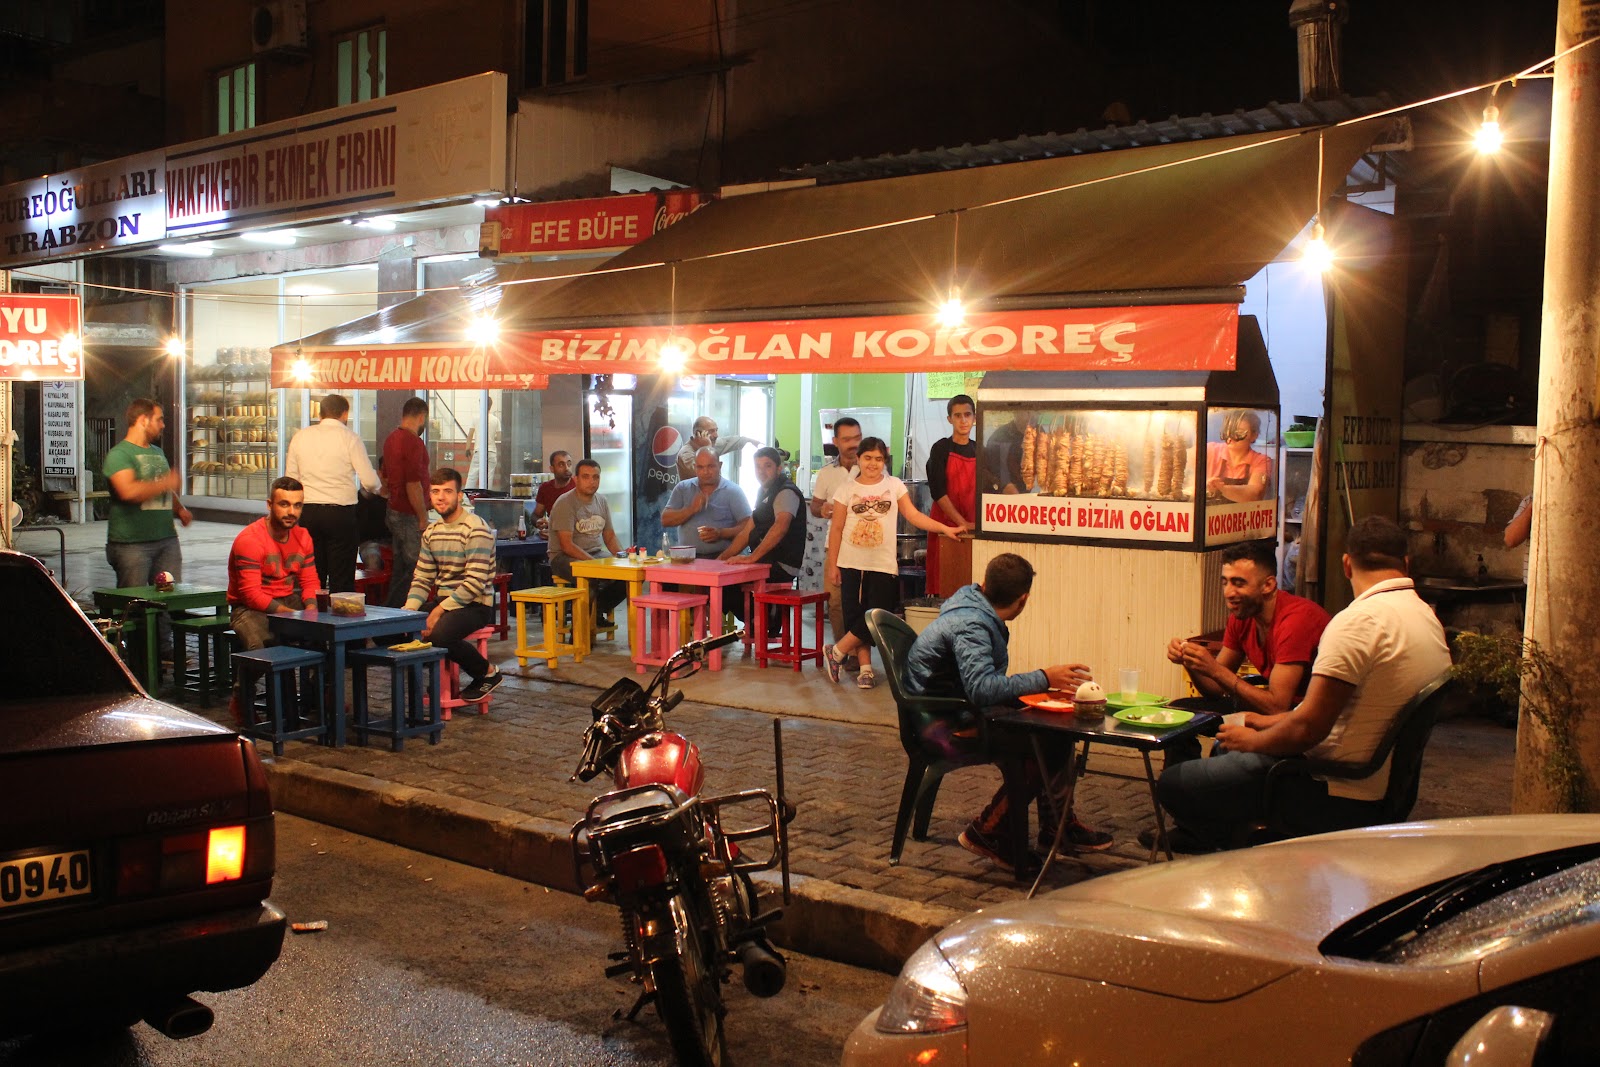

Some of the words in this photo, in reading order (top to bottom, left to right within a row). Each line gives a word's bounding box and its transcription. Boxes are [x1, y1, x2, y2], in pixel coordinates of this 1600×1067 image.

[166, 146, 259, 219] VAKFIKEBİR
[265, 138, 330, 204] EKMEK
[336, 125, 397, 194] FIRINI
[5, 213, 141, 255] TRABZON
[530, 219, 571, 244] EFE
[578, 212, 639, 241] BÜFE
[0, 307, 47, 334] YU
[852, 322, 1137, 362] KOKOREÇ
[647, 467, 680, 485] pepsi
[985, 502, 1072, 531] KOKOREÇCİ
[1077, 502, 1124, 530] BİZİM
[1130, 505, 1190, 533] OĞLAN
[0, 853, 90, 902] 0940
